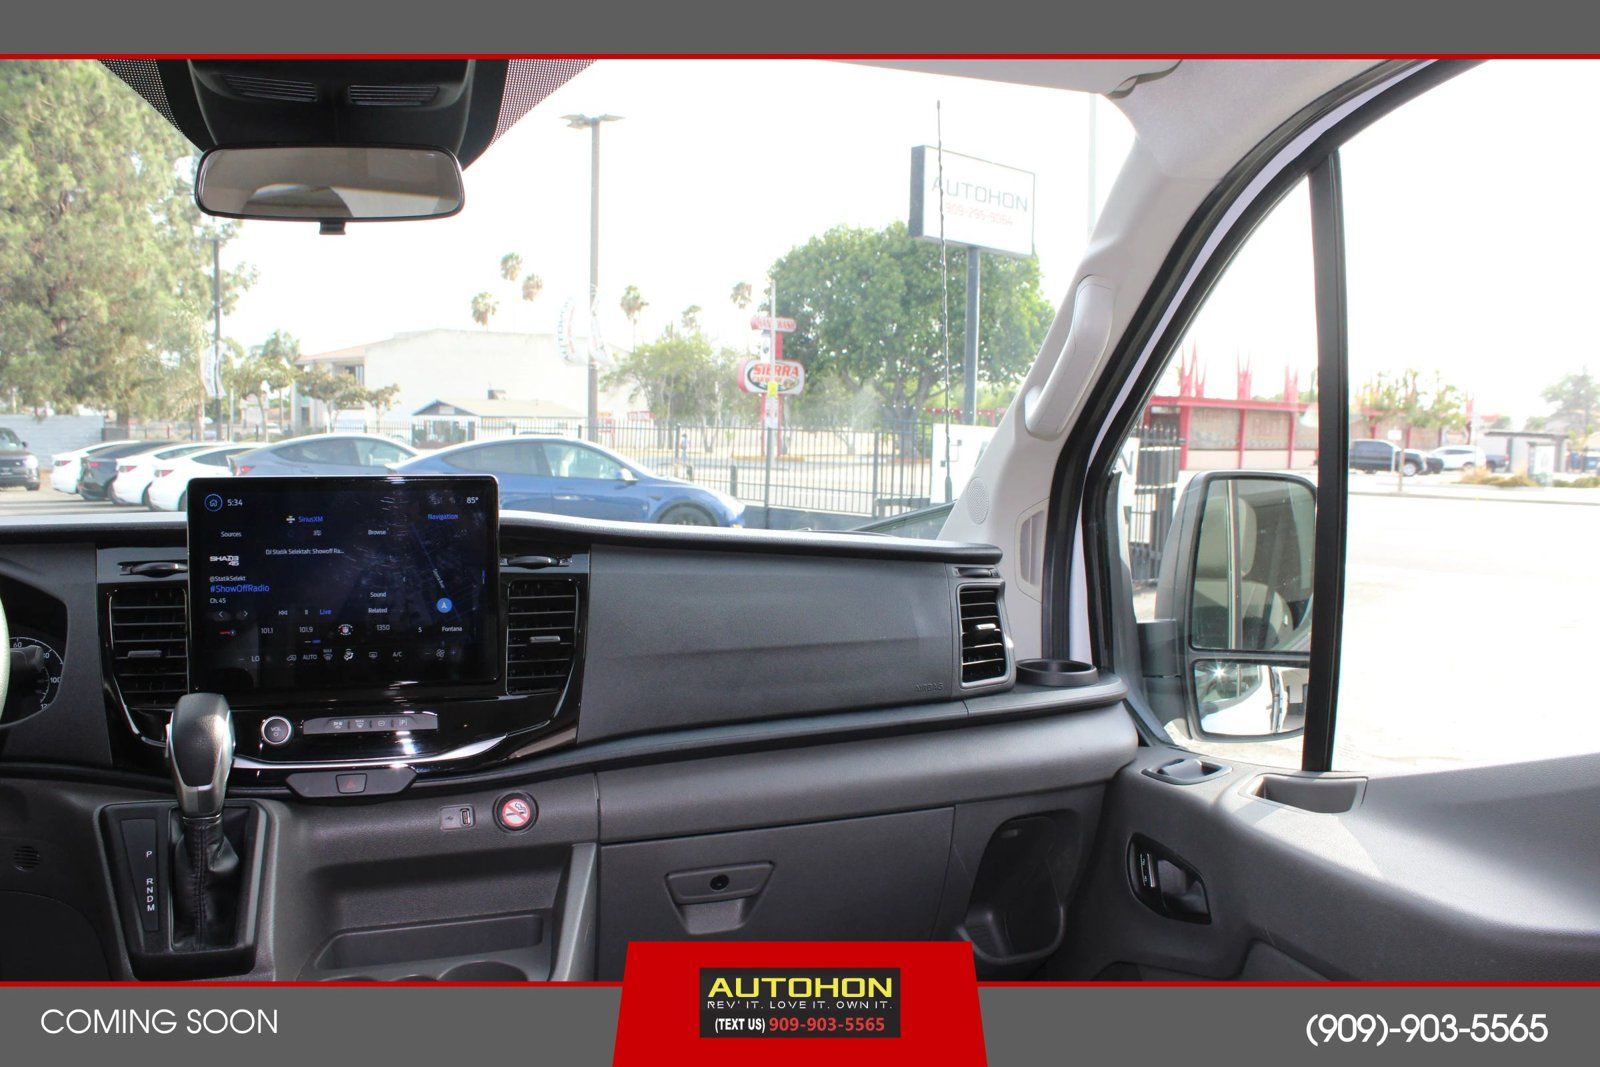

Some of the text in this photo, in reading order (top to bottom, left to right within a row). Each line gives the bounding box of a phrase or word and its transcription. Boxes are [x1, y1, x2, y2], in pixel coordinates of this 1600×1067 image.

[932, 176, 1028, 213] AUTOHON
[227, 498, 243, 507] 5:34
[298, 515, 324, 523] SiriusXM
[427, 513, 459, 521] Navigation
[210, 584, 270, 593] #ShowOffRadio
[146, 850, 153, 858] P
[146, 904, 155, 912] M
